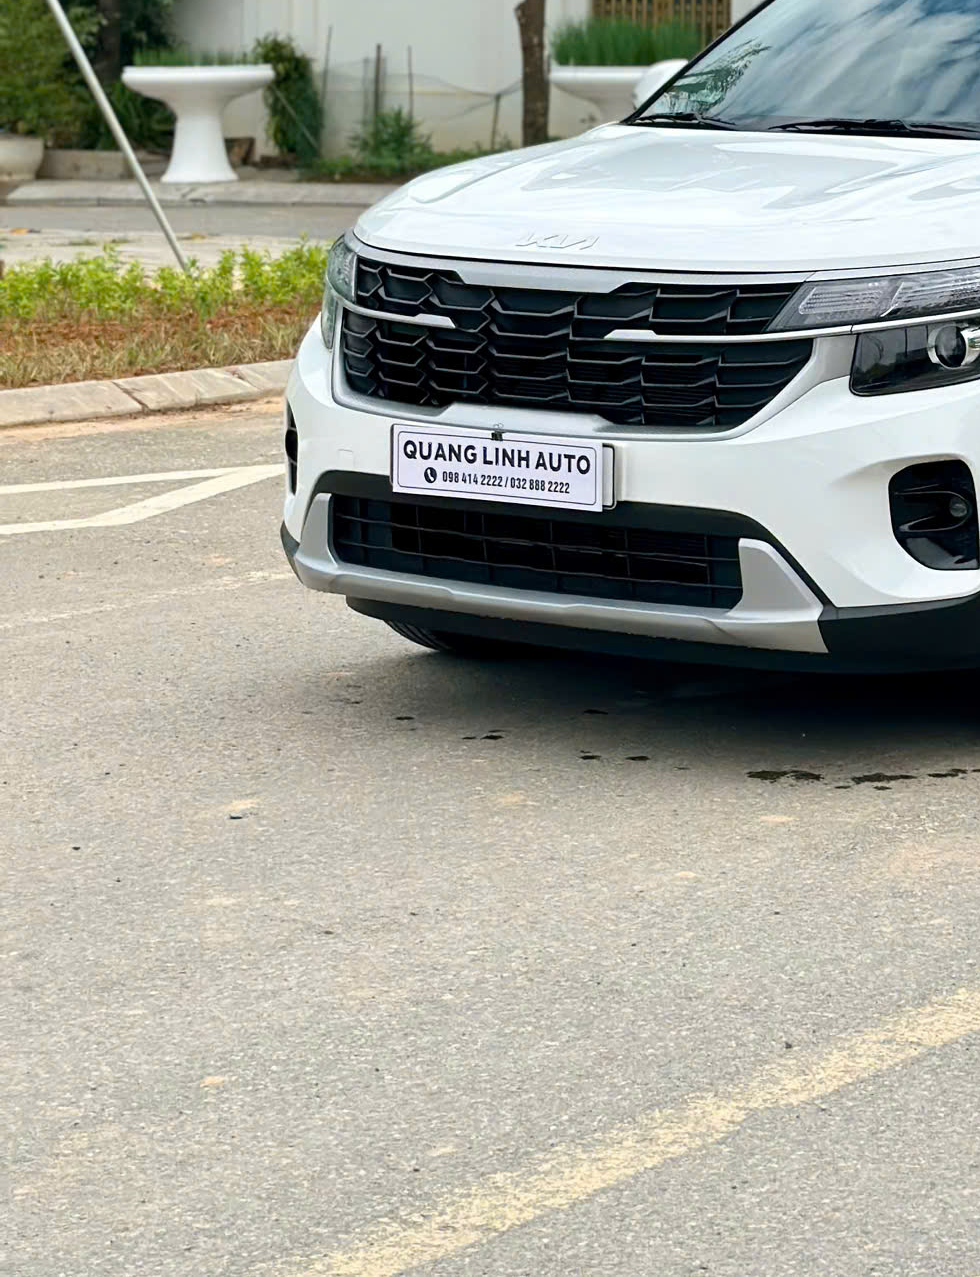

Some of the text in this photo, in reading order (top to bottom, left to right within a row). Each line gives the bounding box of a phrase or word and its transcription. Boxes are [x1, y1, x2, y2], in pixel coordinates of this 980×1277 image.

[403, 440, 591, 475] QUANG LINH AUTO
[442, 471, 460, 483] 098
[461, 473, 479, 485] 414
[480, 474, 503, 487] 2222
[510, 477, 527, 490] 032
[529, 478, 546, 492] 888
[547, 481, 570, 494] 2222
